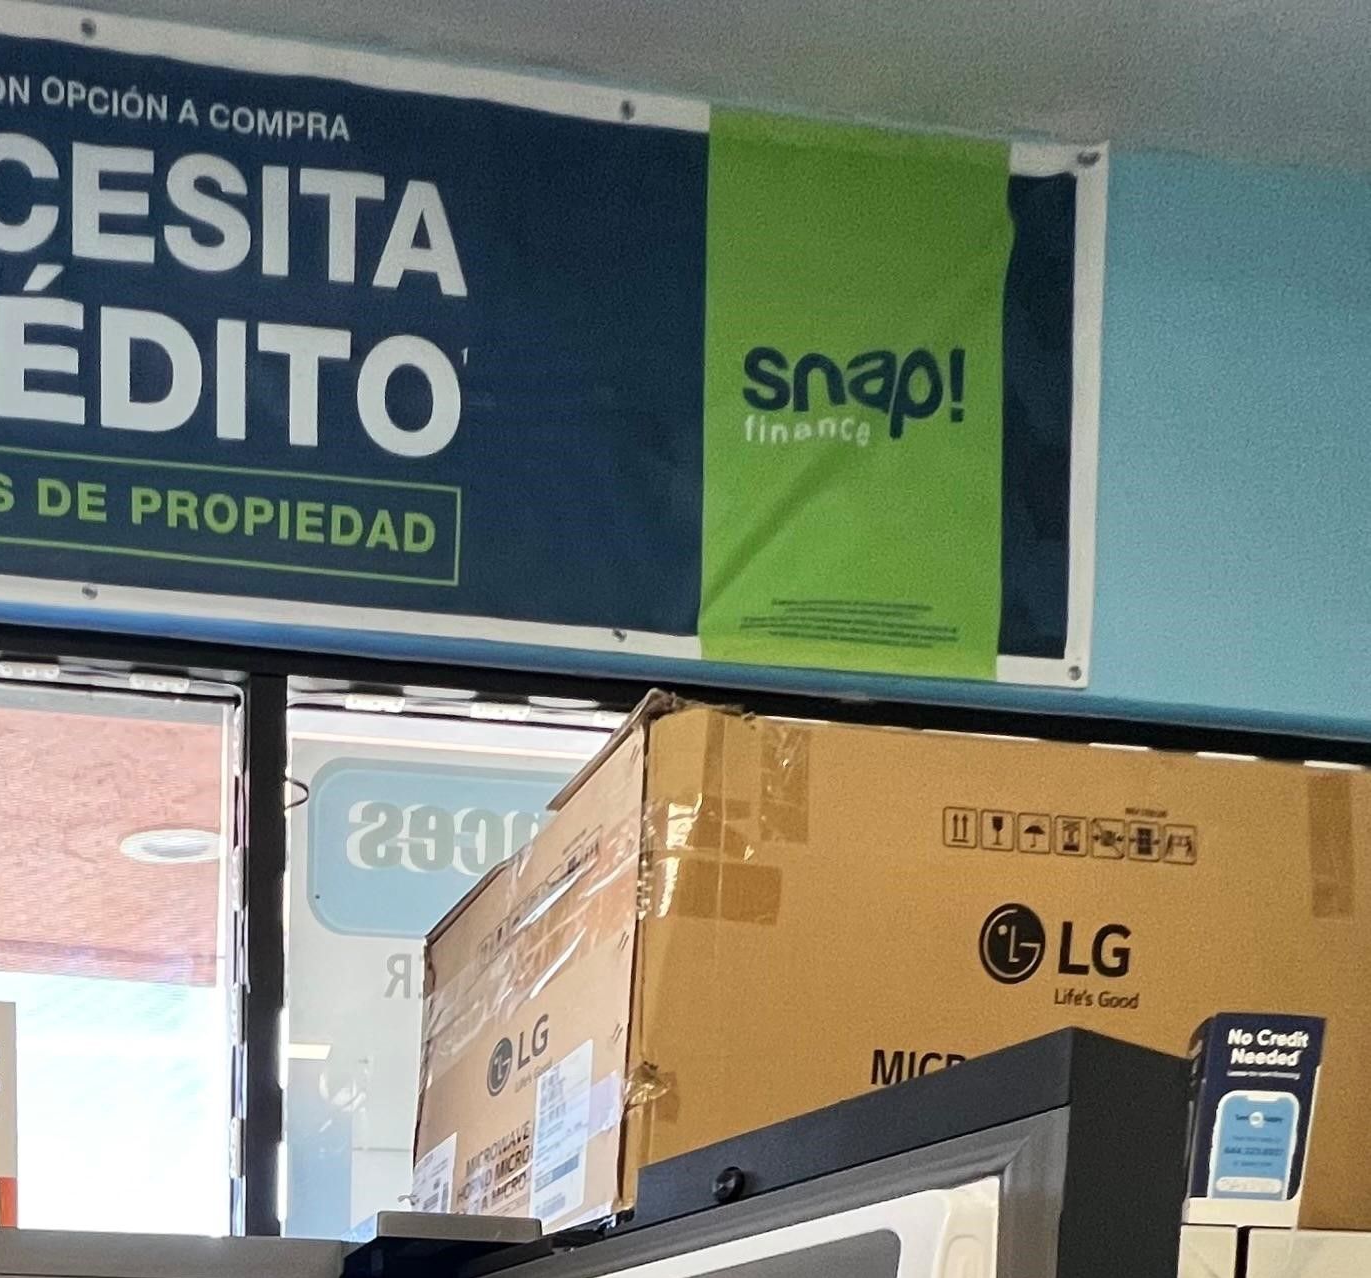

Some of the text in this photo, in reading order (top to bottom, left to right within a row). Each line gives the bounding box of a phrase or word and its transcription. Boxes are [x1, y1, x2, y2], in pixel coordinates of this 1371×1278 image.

[41, 75, 168, 122] OPCIÓN
[178, 100, 199, 126] A
[209, 103, 351, 141] COMPRA
[742, 346, 966, 439] snap!
[744, 415, 871, 447] finance
[38, 478, 107, 522] DE
[132, 486, 437, 554] PROPIEDAD
[1058, 921, 1131, 978] LG
[1054, 988, 1139, 1009] Life's Good
[518, 1013, 549, 1070] LG
[1227, 1029, 1309, 1047] No Credit
[1230, 1048, 1302, 1066] Needed
